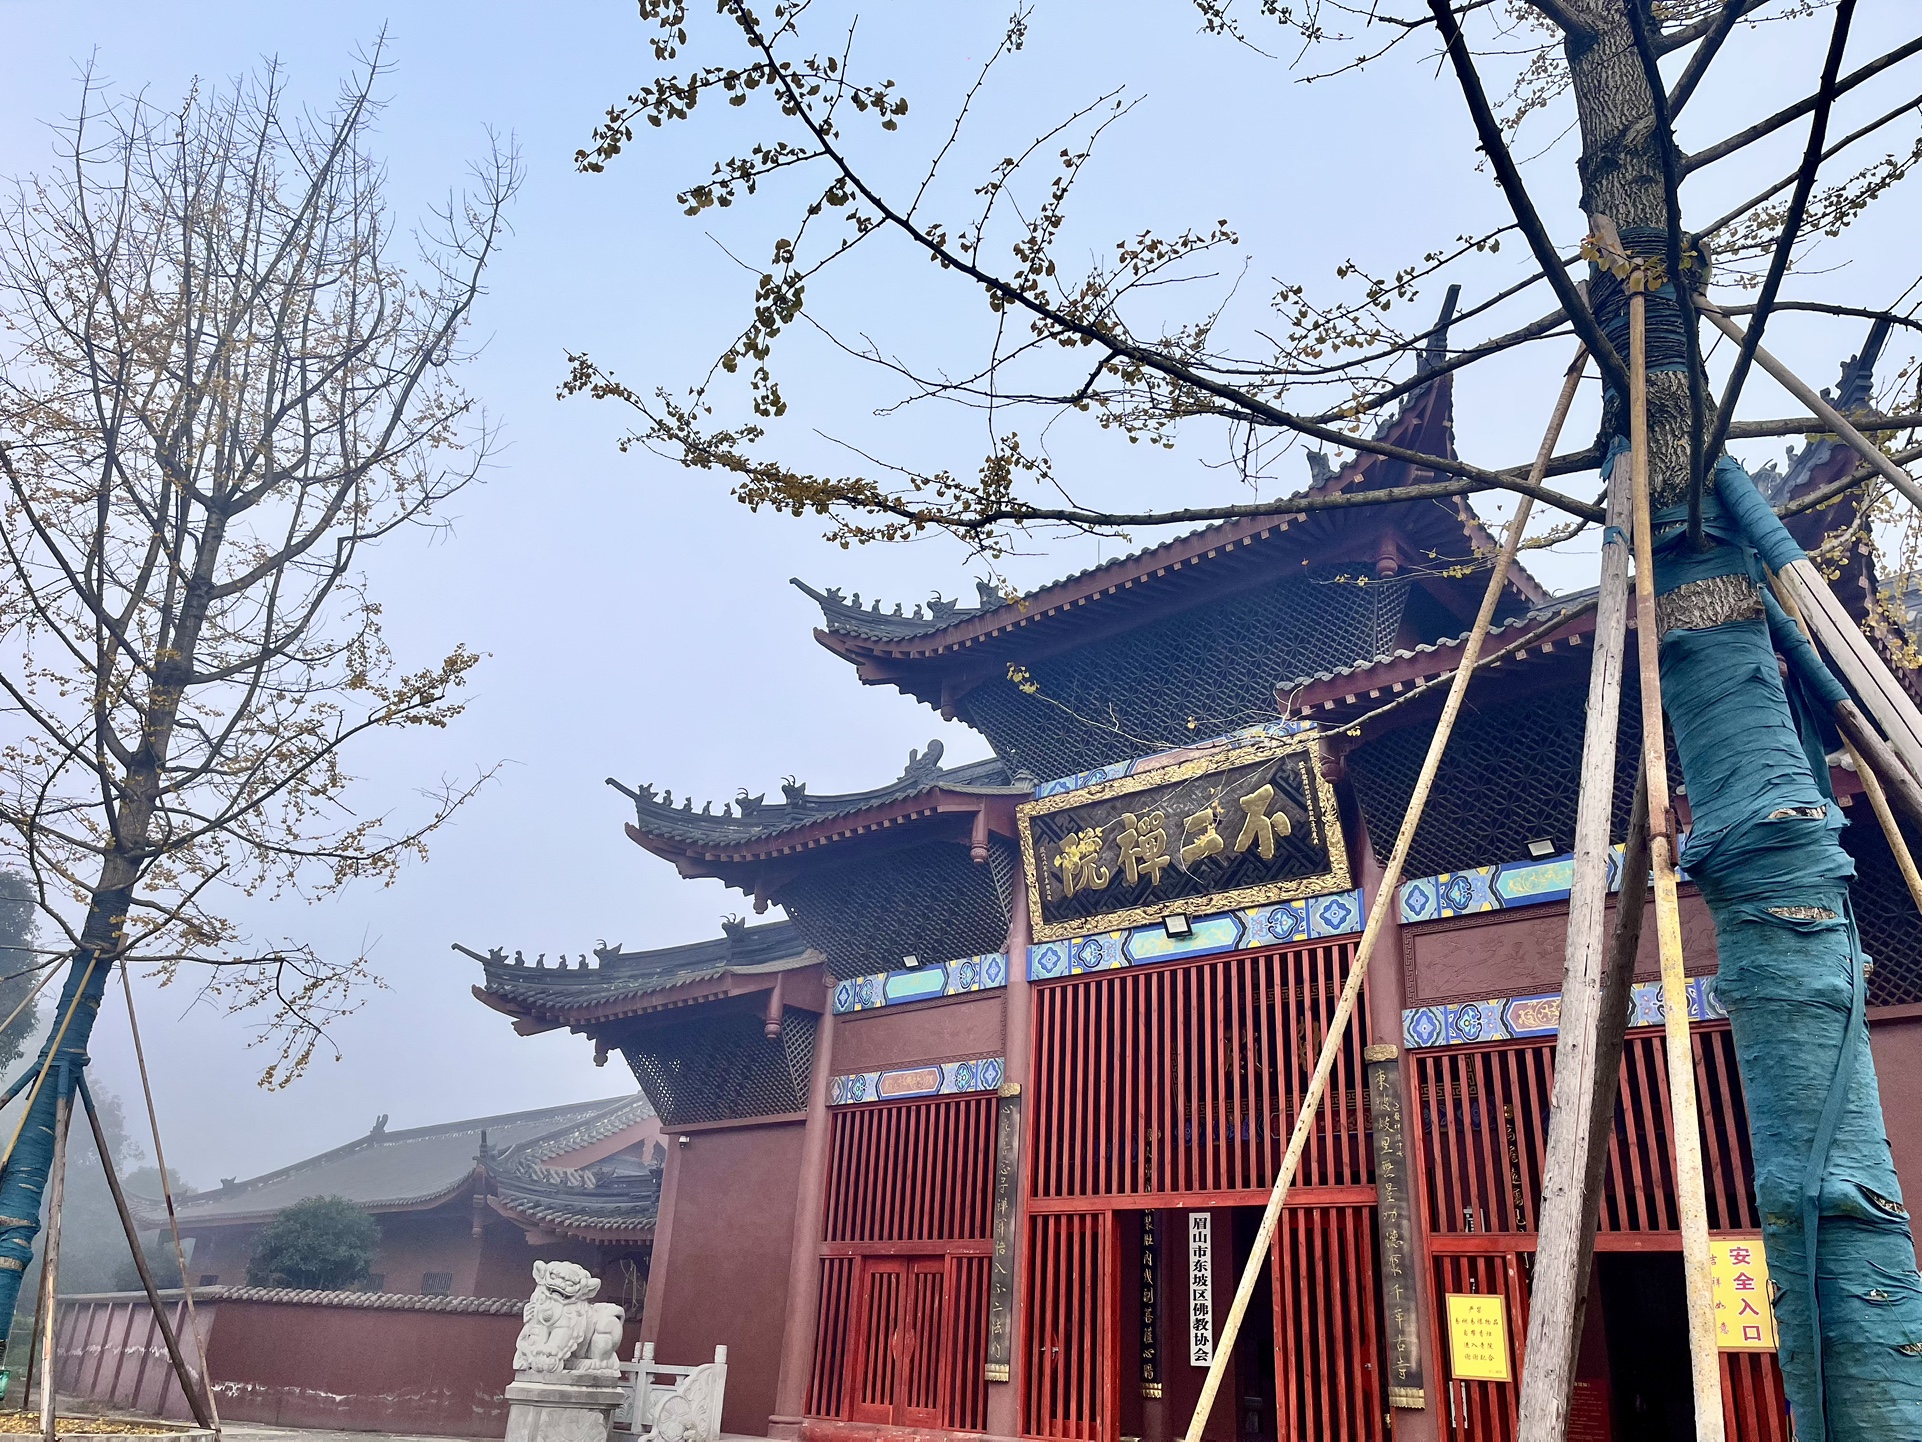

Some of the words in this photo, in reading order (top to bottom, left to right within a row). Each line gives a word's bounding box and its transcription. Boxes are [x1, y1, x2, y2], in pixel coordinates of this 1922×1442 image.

[1192, 1216, 1210, 1362] 眉山市东坡区佛教协会
[1729, 1246, 1762, 1341] 安全入口
